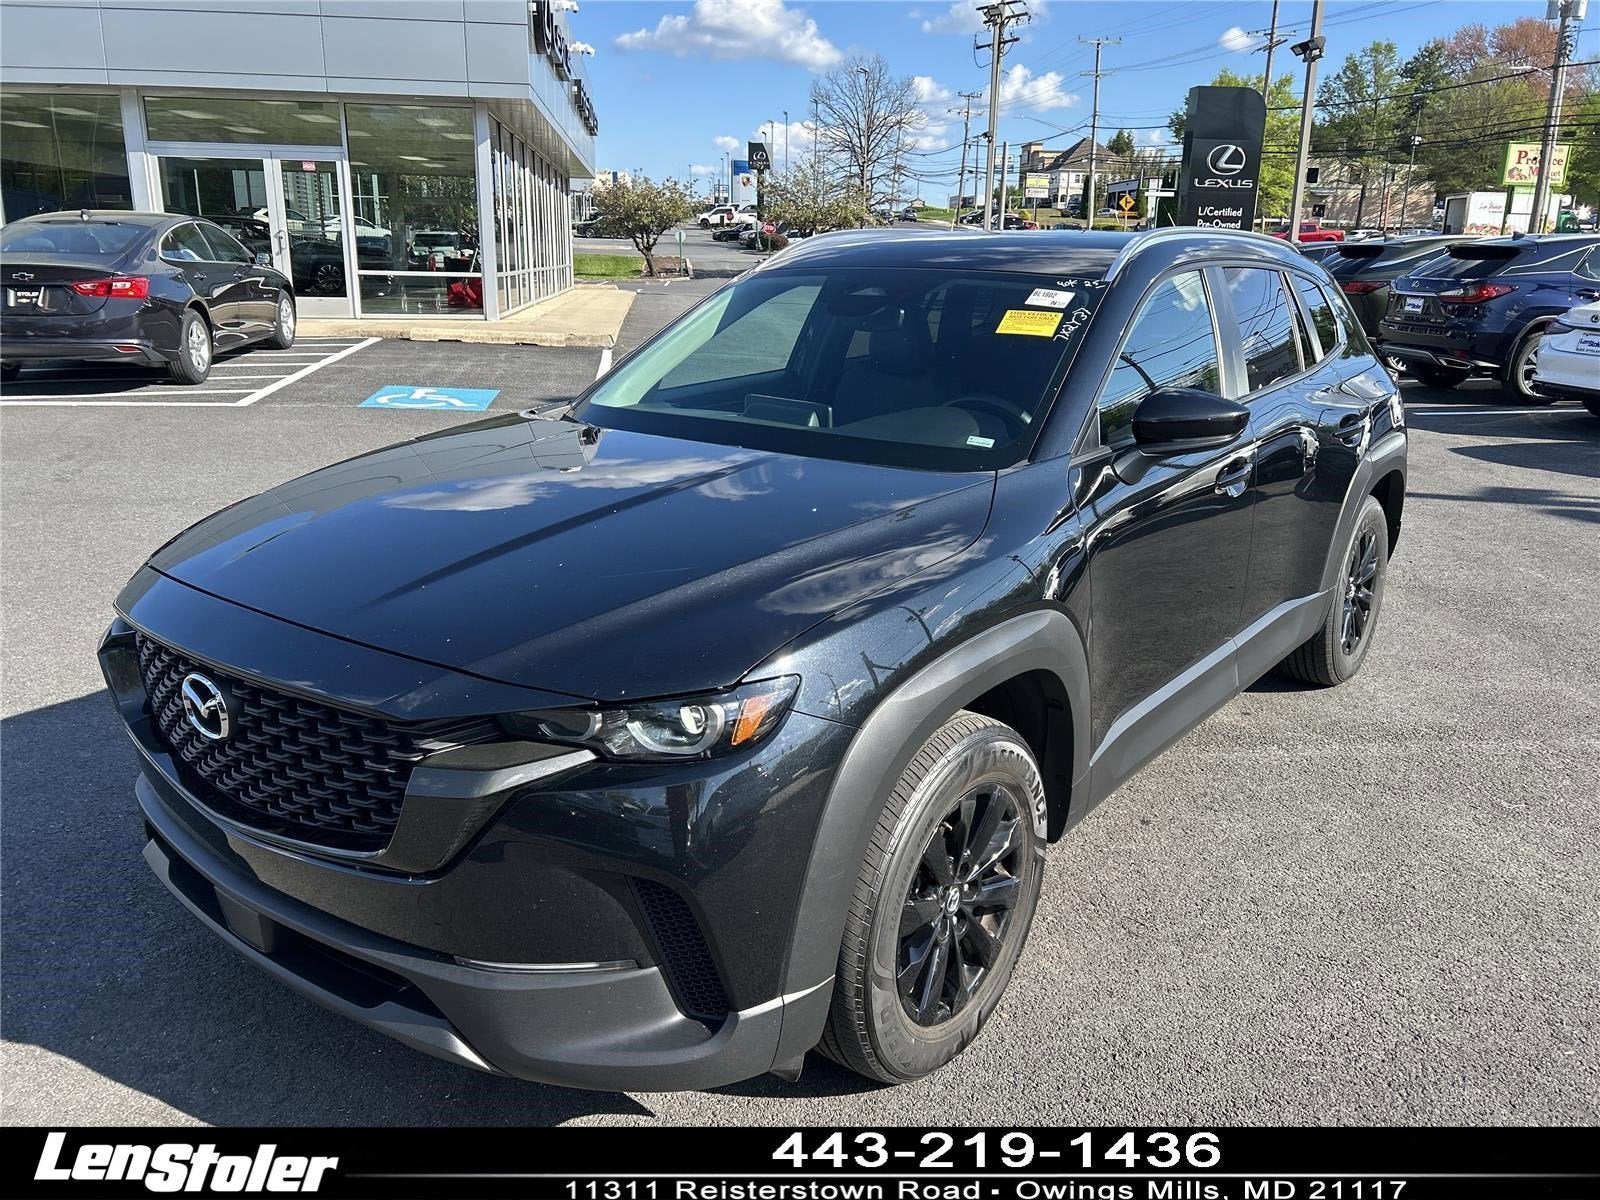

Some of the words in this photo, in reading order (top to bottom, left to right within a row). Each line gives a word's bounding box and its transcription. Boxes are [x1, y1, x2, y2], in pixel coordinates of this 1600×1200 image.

[1516, 150, 1564, 166] Proce
[1529, 166, 1561, 177] Met
[1194, 178, 1254, 188] LEXUS
[1197, 206, 1243, 218] L/Certified
[1197, 219, 1241, 229] Pre-Owned
